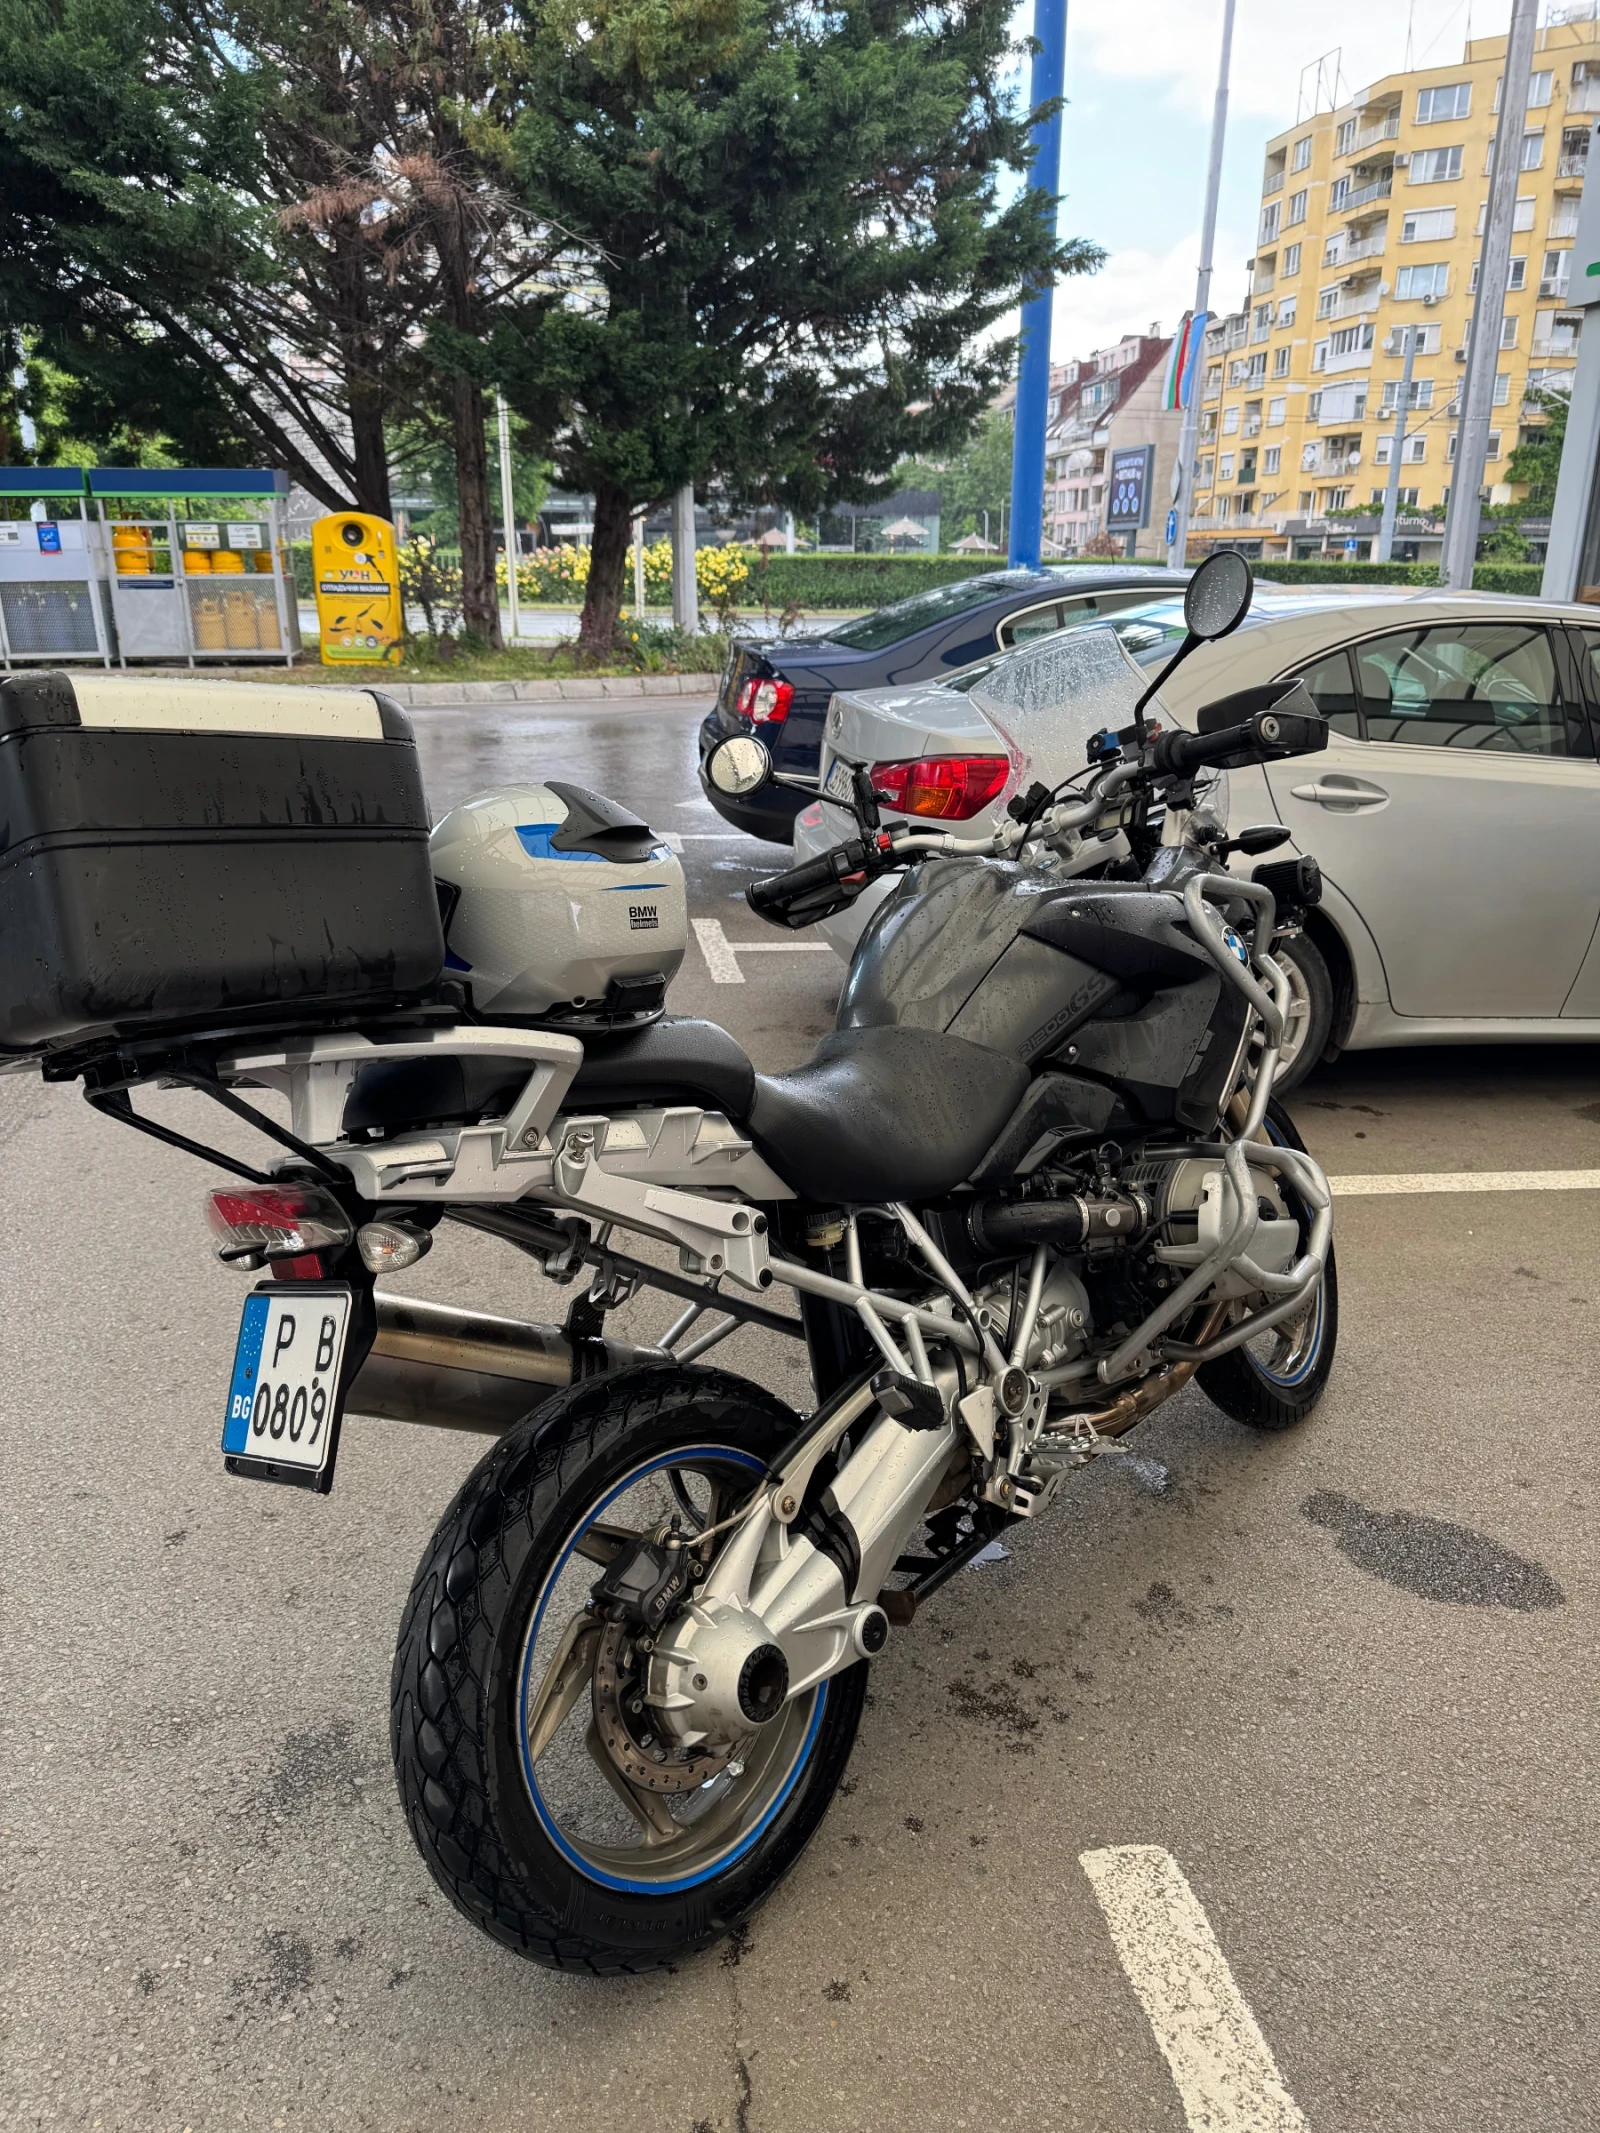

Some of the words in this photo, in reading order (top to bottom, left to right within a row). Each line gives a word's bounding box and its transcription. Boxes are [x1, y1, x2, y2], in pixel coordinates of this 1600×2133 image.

[629, 905, 657, 918] BMW
[273, 1313, 296, 1369] P
[315, 1315, 337, 1372] B
[231, 1394, 252, 1420] BG
[252, 1382, 327, 1445] 0809
[655, 1575, 680, 1611] BMW
